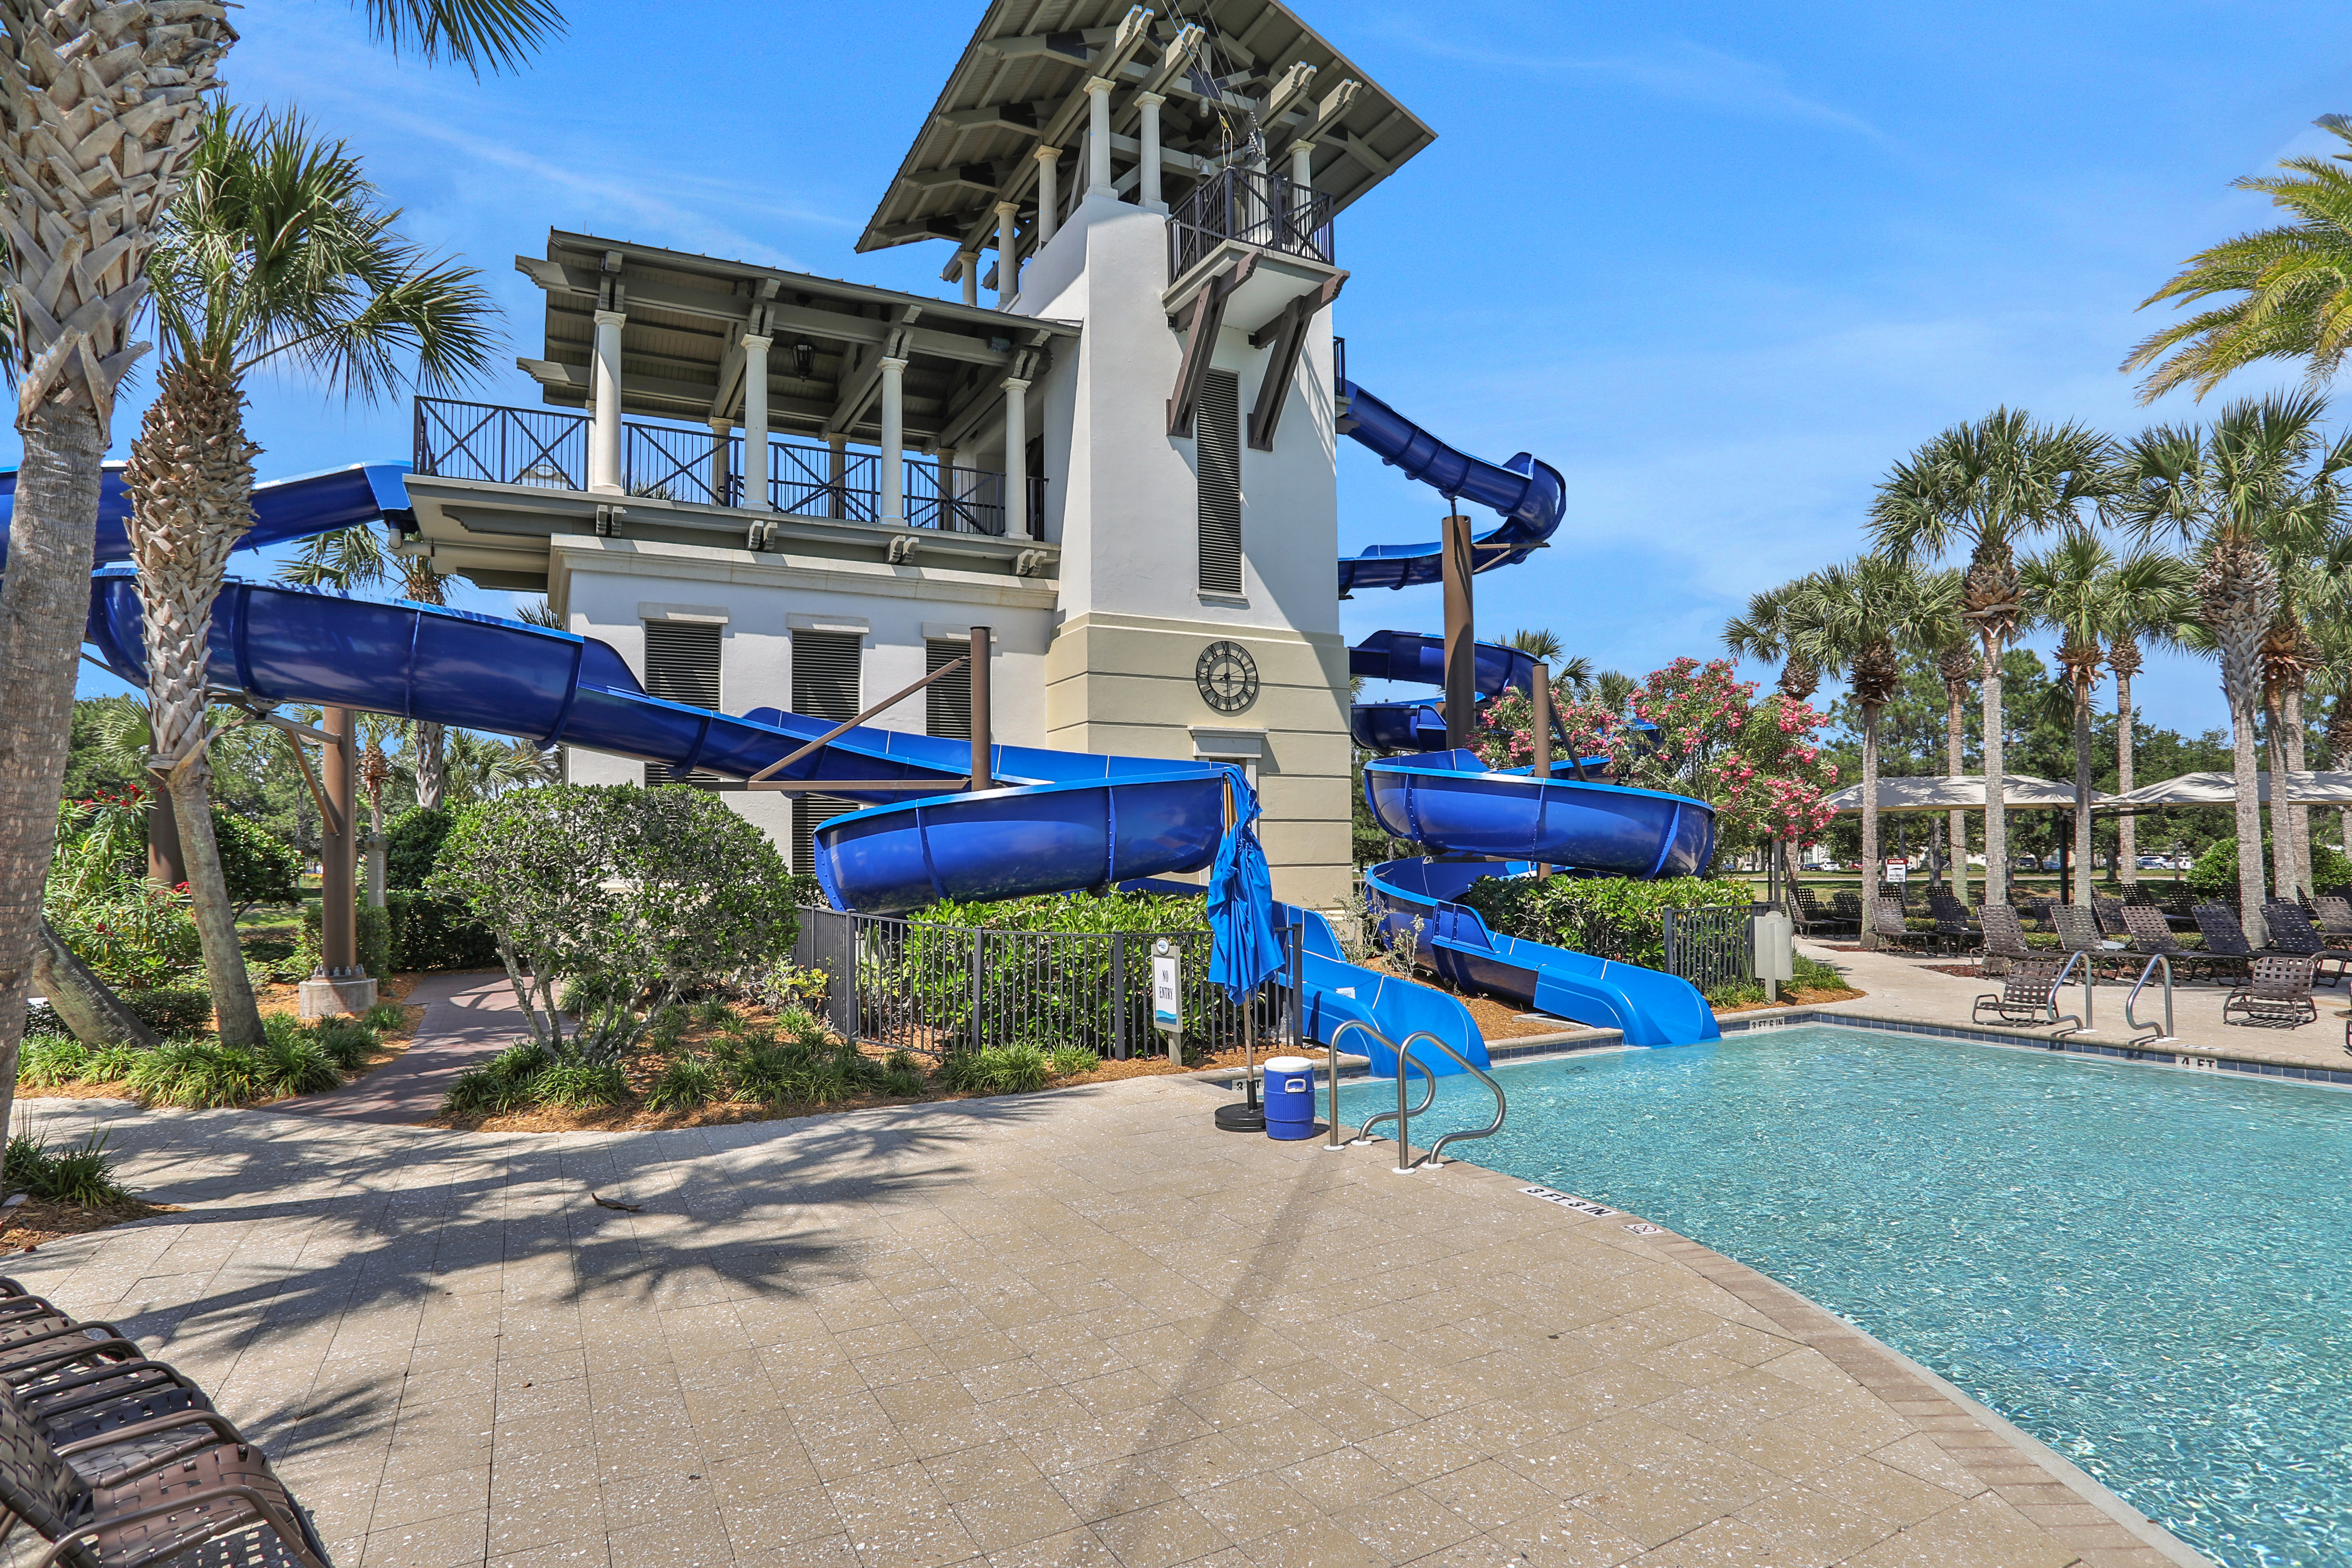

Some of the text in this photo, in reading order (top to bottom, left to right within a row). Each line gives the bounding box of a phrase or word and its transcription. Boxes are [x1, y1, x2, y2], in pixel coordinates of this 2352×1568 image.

[1162, 970, 1169, 983] NO
[1159, 986, 1173, 1000] ENTRY
[1237, 1082, 1243, 1091] 3
[1542, 1193, 1571, 1202] FT.
[1582, 1207, 1612, 1217] IN.
